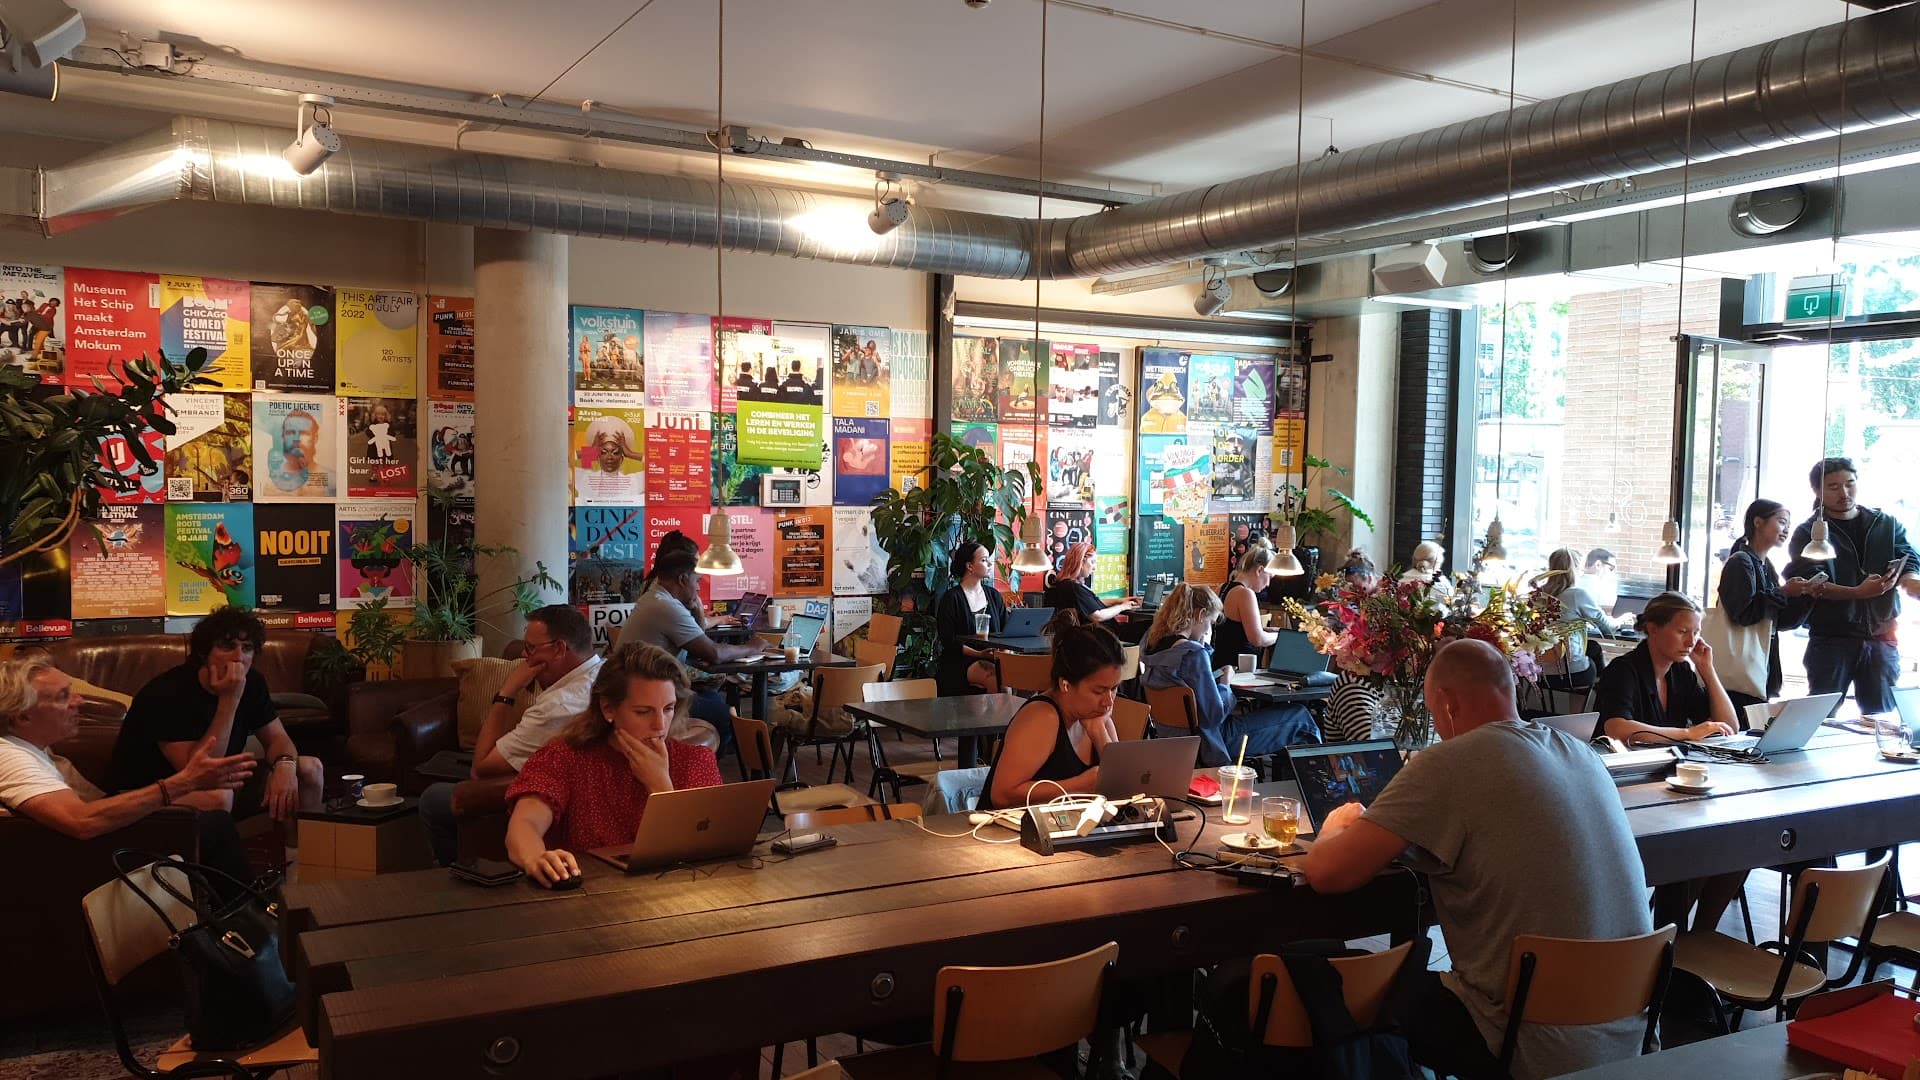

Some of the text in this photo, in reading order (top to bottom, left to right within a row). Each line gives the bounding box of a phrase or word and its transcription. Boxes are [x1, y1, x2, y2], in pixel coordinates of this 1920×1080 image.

[2, 271, 57, 280] METAVERSE
[73, 283, 127, 295] Museum
[342, 292, 413, 305] THIS ART FAIR
[74, 298, 134, 312] Het Schip
[364, 303, 374, 311] 10
[376, 304, 401, 313] JULY
[74, 312, 114, 323] maakt
[183, 309, 228, 318] CHICAGO
[341, 309, 365, 319] 2022
[435, 312, 454, 321] PUNK
[183, 317, 227, 329] COMEDY
[580, 315, 637, 329] volkstuin
[74, 325, 147, 338] Amsterdam
[183, 328, 227, 341] FESTIVAL
[74, 340, 121, 351] Mokum
[276, 349, 312, 360] ONCE
[381, 355, 412, 364] ARTISTS
[277, 359, 311, 369] UPN
[274, 367, 315, 379] A TIME
[269, 402, 320, 411] POETIC LICENCE
[651, 411, 700, 429] Juni
[750, 410, 811, 421] COMBINEER HET
[745, 418, 816, 429] LEREN EN WERKEN
[834, 418, 855, 426] TALA
[746, 426, 815, 437] IN DE BEVEILIGING
[834, 425, 866, 434] MADANI
[1166, 450, 1196, 460] VINTAGE
[1217, 454, 1245, 463] ORDER
[349, 456, 400, 465] Girl lost her
[349, 466, 369, 475] bear
[379, 465, 408, 480] LOST
[229, 487, 249, 495] 360
[338, 505, 357, 513] ARTIS
[176, 513, 225, 521] AMSTERDAM
[585, 508, 635, 524] CINE
[1049, 511, 1073, 519] CINE
[650, 517, 681, 526] Oxville
[777, 519, 794, 529] PUNK
[176, 527, 213, 535] FESTIVAL
[586, 525, 639, 542] DANS
[177, 534, 208, 542] 40 JAAR
[260, 530, 331, 556] NOOIT
[806, 602, 828, 616] DAS
[262, 615, 332, 626] heater Bellevue
[26, 624, 67, 633] Bellevue
